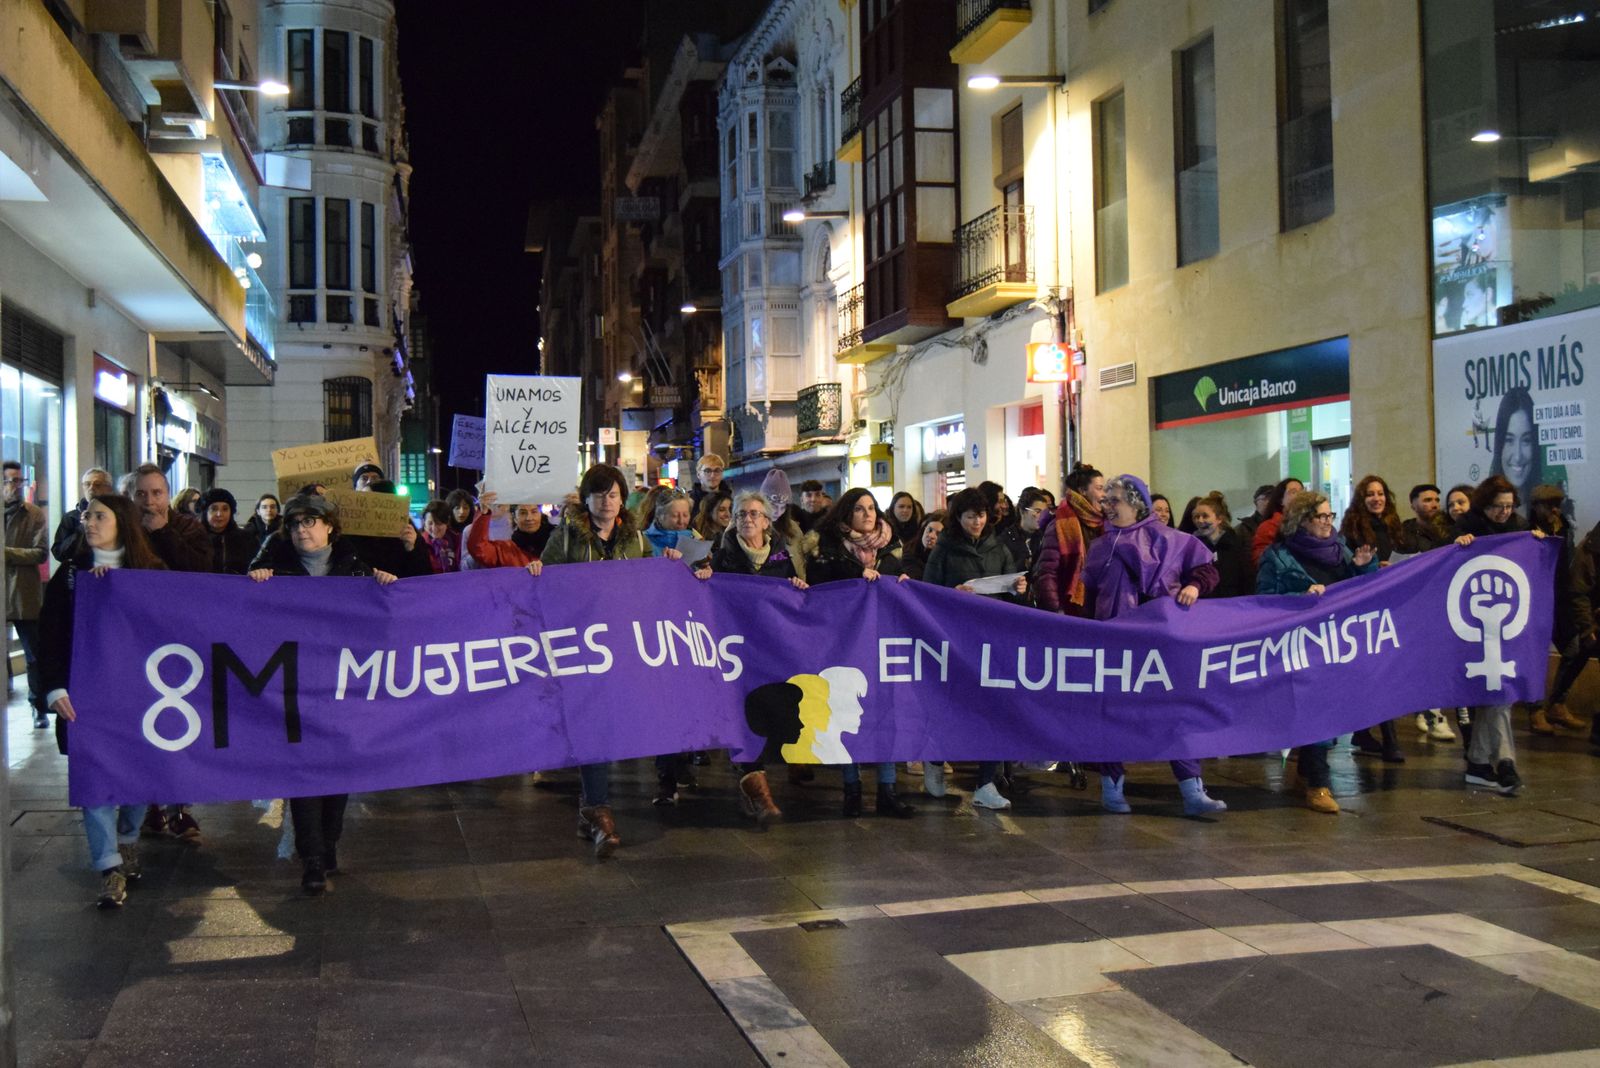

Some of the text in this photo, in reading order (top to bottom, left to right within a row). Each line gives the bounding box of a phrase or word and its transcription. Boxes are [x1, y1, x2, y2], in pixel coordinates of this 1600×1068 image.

[1465, 334, 1584, 400] SOMOS MÁS
[496, 387, 562, 402] UNAMOS
[1219, 379, 1296, 406] Unicaja Banco
[1535, 410, 1544, 420] EN
[1544, 408, 1553, 419] TU
[1553, 404, 1564, 418] DÍA
[1541, 430, 1549, 441] EN
[1549, 428, 1558, 440] TU
[511, 454, 551, 474] VOZ
[1549, 451, 1557, 462] EN
[1558, 450, 1567, 461] TU
[142, 641, 302, 751] 8M
[335, 623, 613, 700] MUJERES
[879, 637, 949, 682] EN
[980, 643, 1173, 693] LUCHA
[1199, 608, 1400, 689] FEMINISTA
